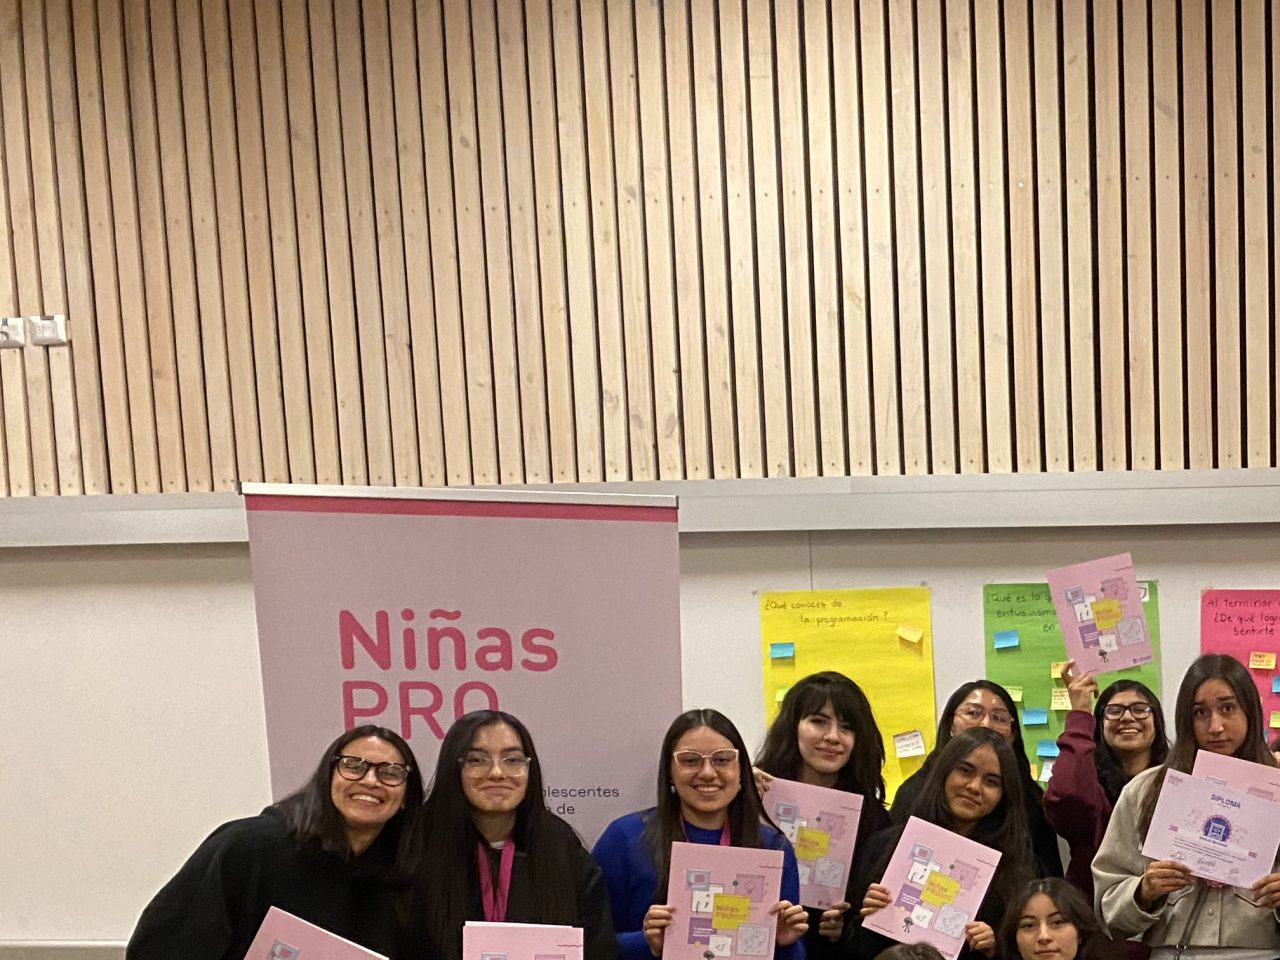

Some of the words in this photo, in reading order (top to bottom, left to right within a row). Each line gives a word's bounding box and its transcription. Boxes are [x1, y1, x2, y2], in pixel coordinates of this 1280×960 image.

[1031, 591, 1040, 601] lo
[765, 600, 787, 611] ¿Qué
[791, 602, 827, 610] conoces
[831, 600, 842, 608] de
[1207, 599, 1218, 607] Al
[800, 614, 810, 624] la
[816, 613, 879, 627] programación
[1213, 613, 1233, 623] ¿De
[1233, 625, 1274, 636] sentirte
[338, 607, 559, 672] Niñas
[542, 786, 620, 798] lescentes
[1210, 794, 1241, 809] DIPLOMA
[556, 803, 575, 815] de
